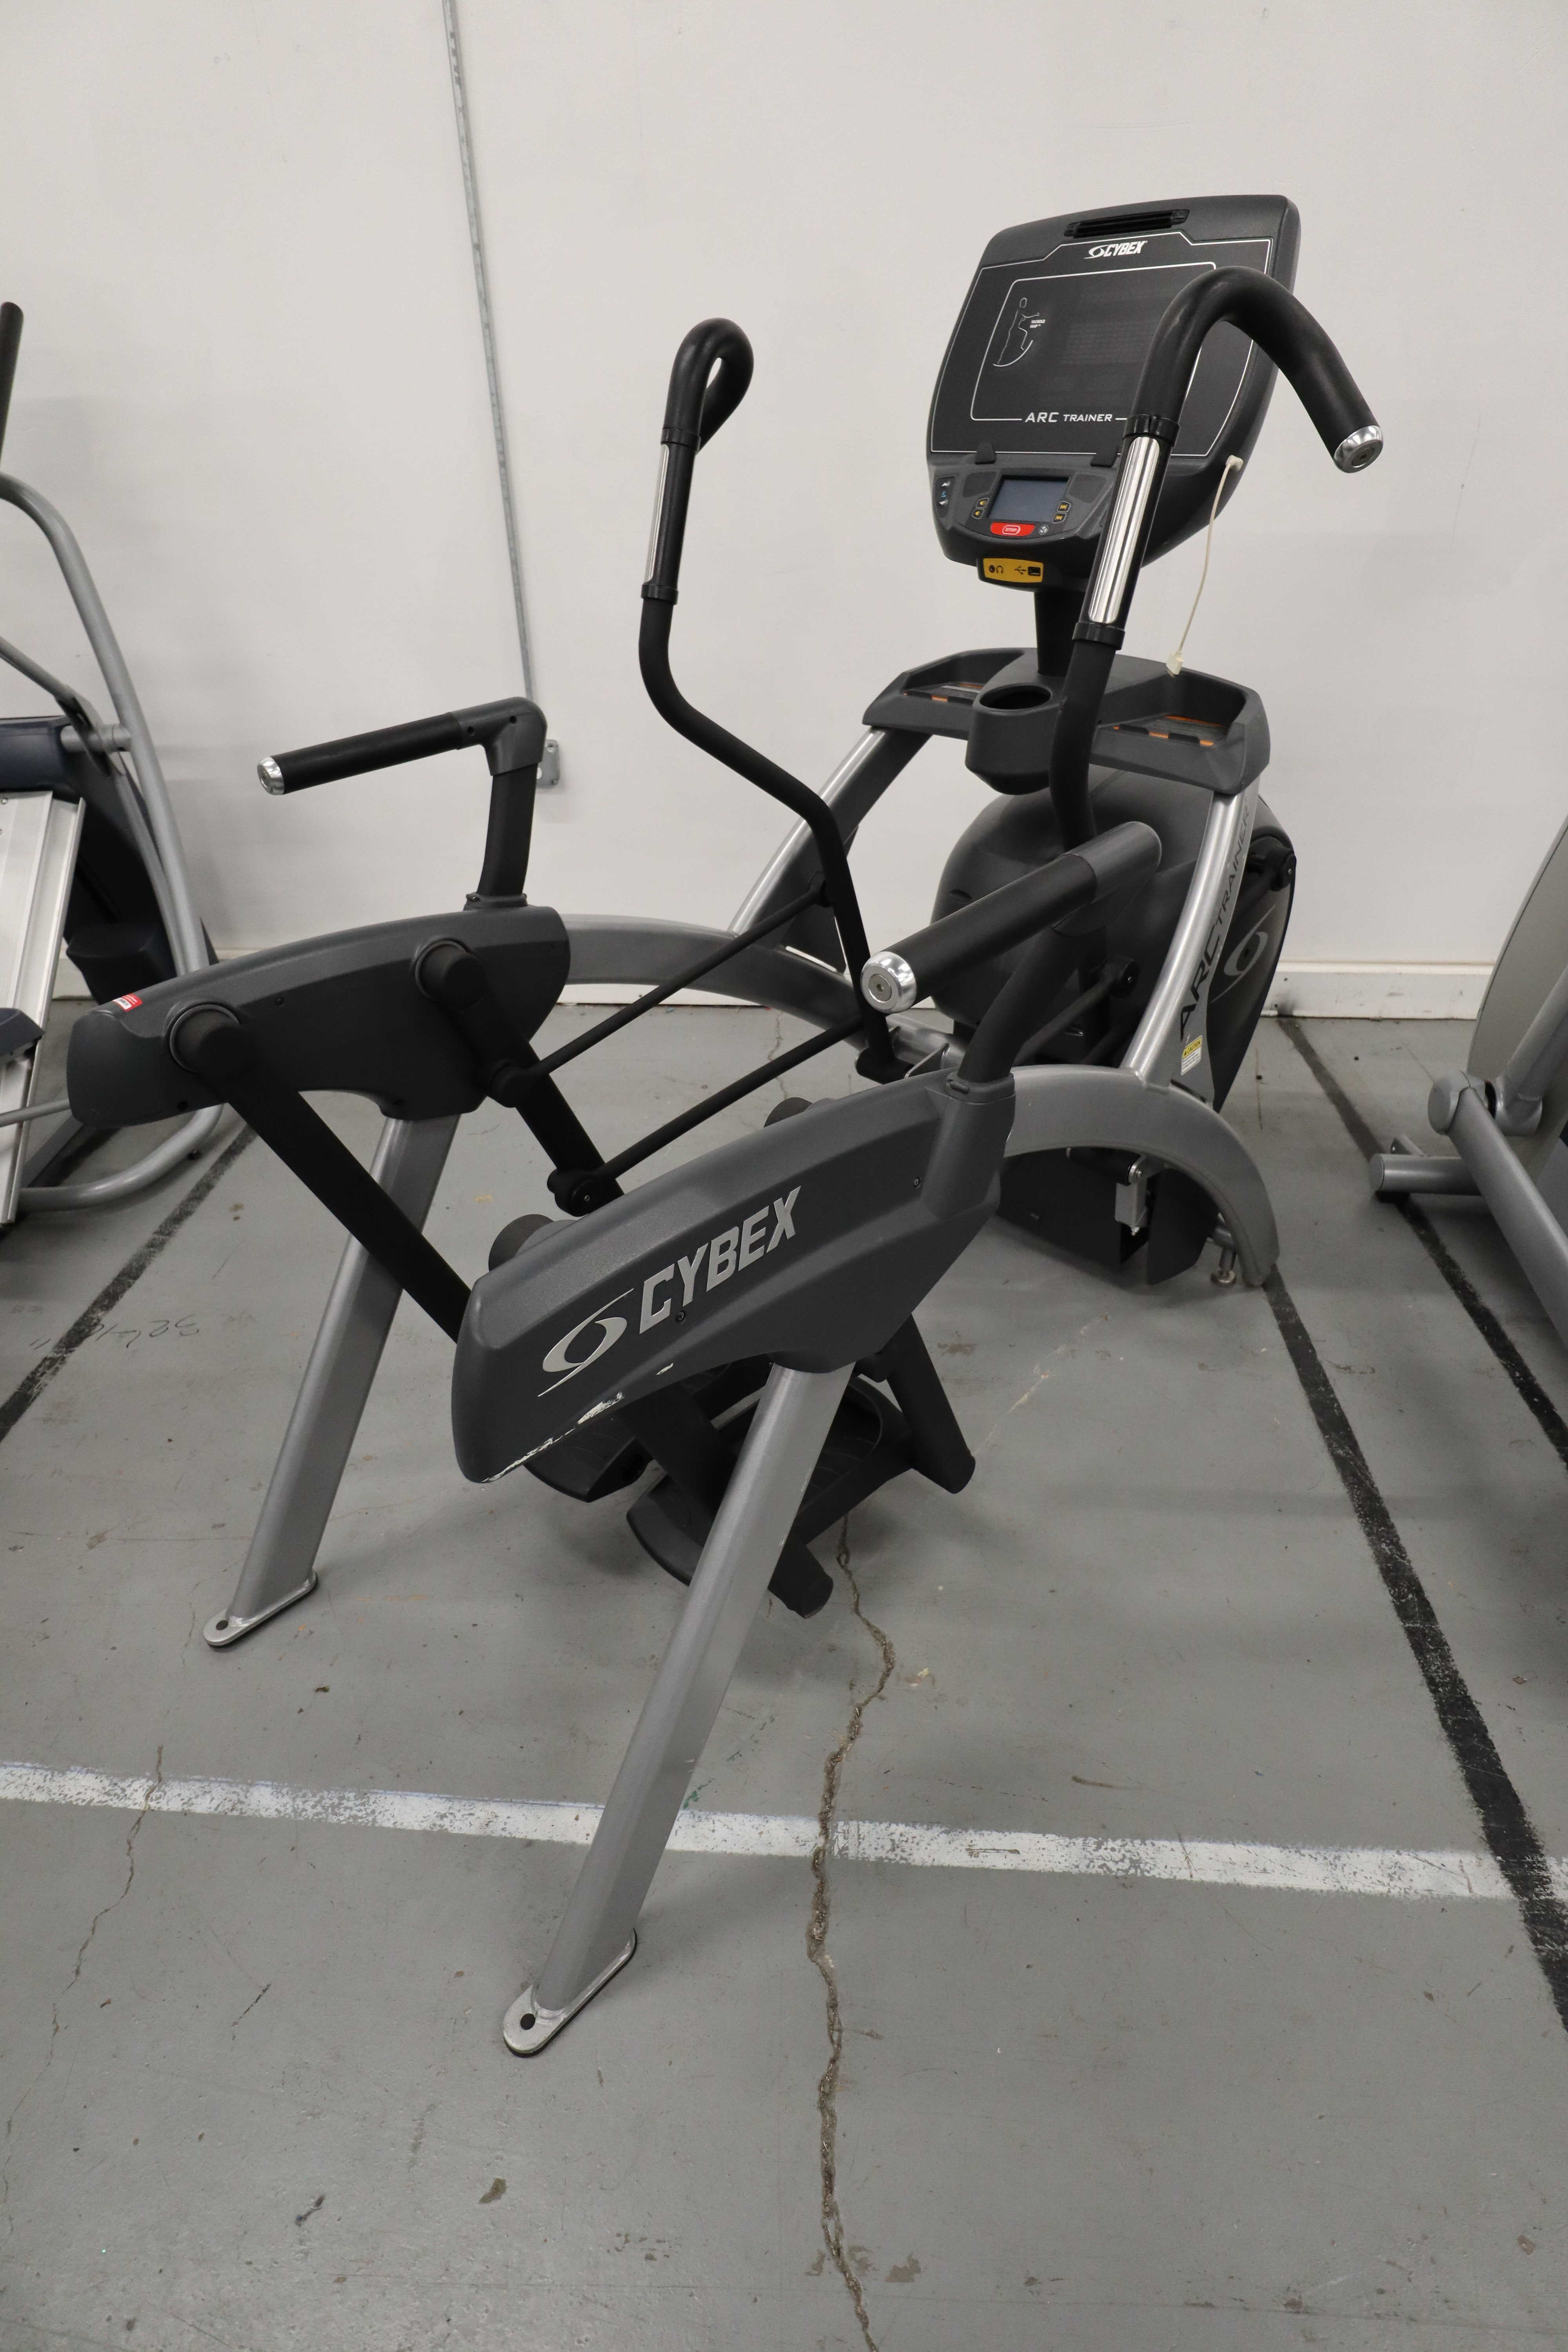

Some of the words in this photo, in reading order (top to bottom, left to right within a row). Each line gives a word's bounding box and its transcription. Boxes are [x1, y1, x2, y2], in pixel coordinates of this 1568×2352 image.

[1103, 240, 1145, 257] CYBEX
[1025, 412, 1060, 423] ARC
[1063, 414, 1113, 422] TRAINER
[1187, 1041, 1200, 1054] CAUTION
[639, 1185, 801, 1335] CYBEX
